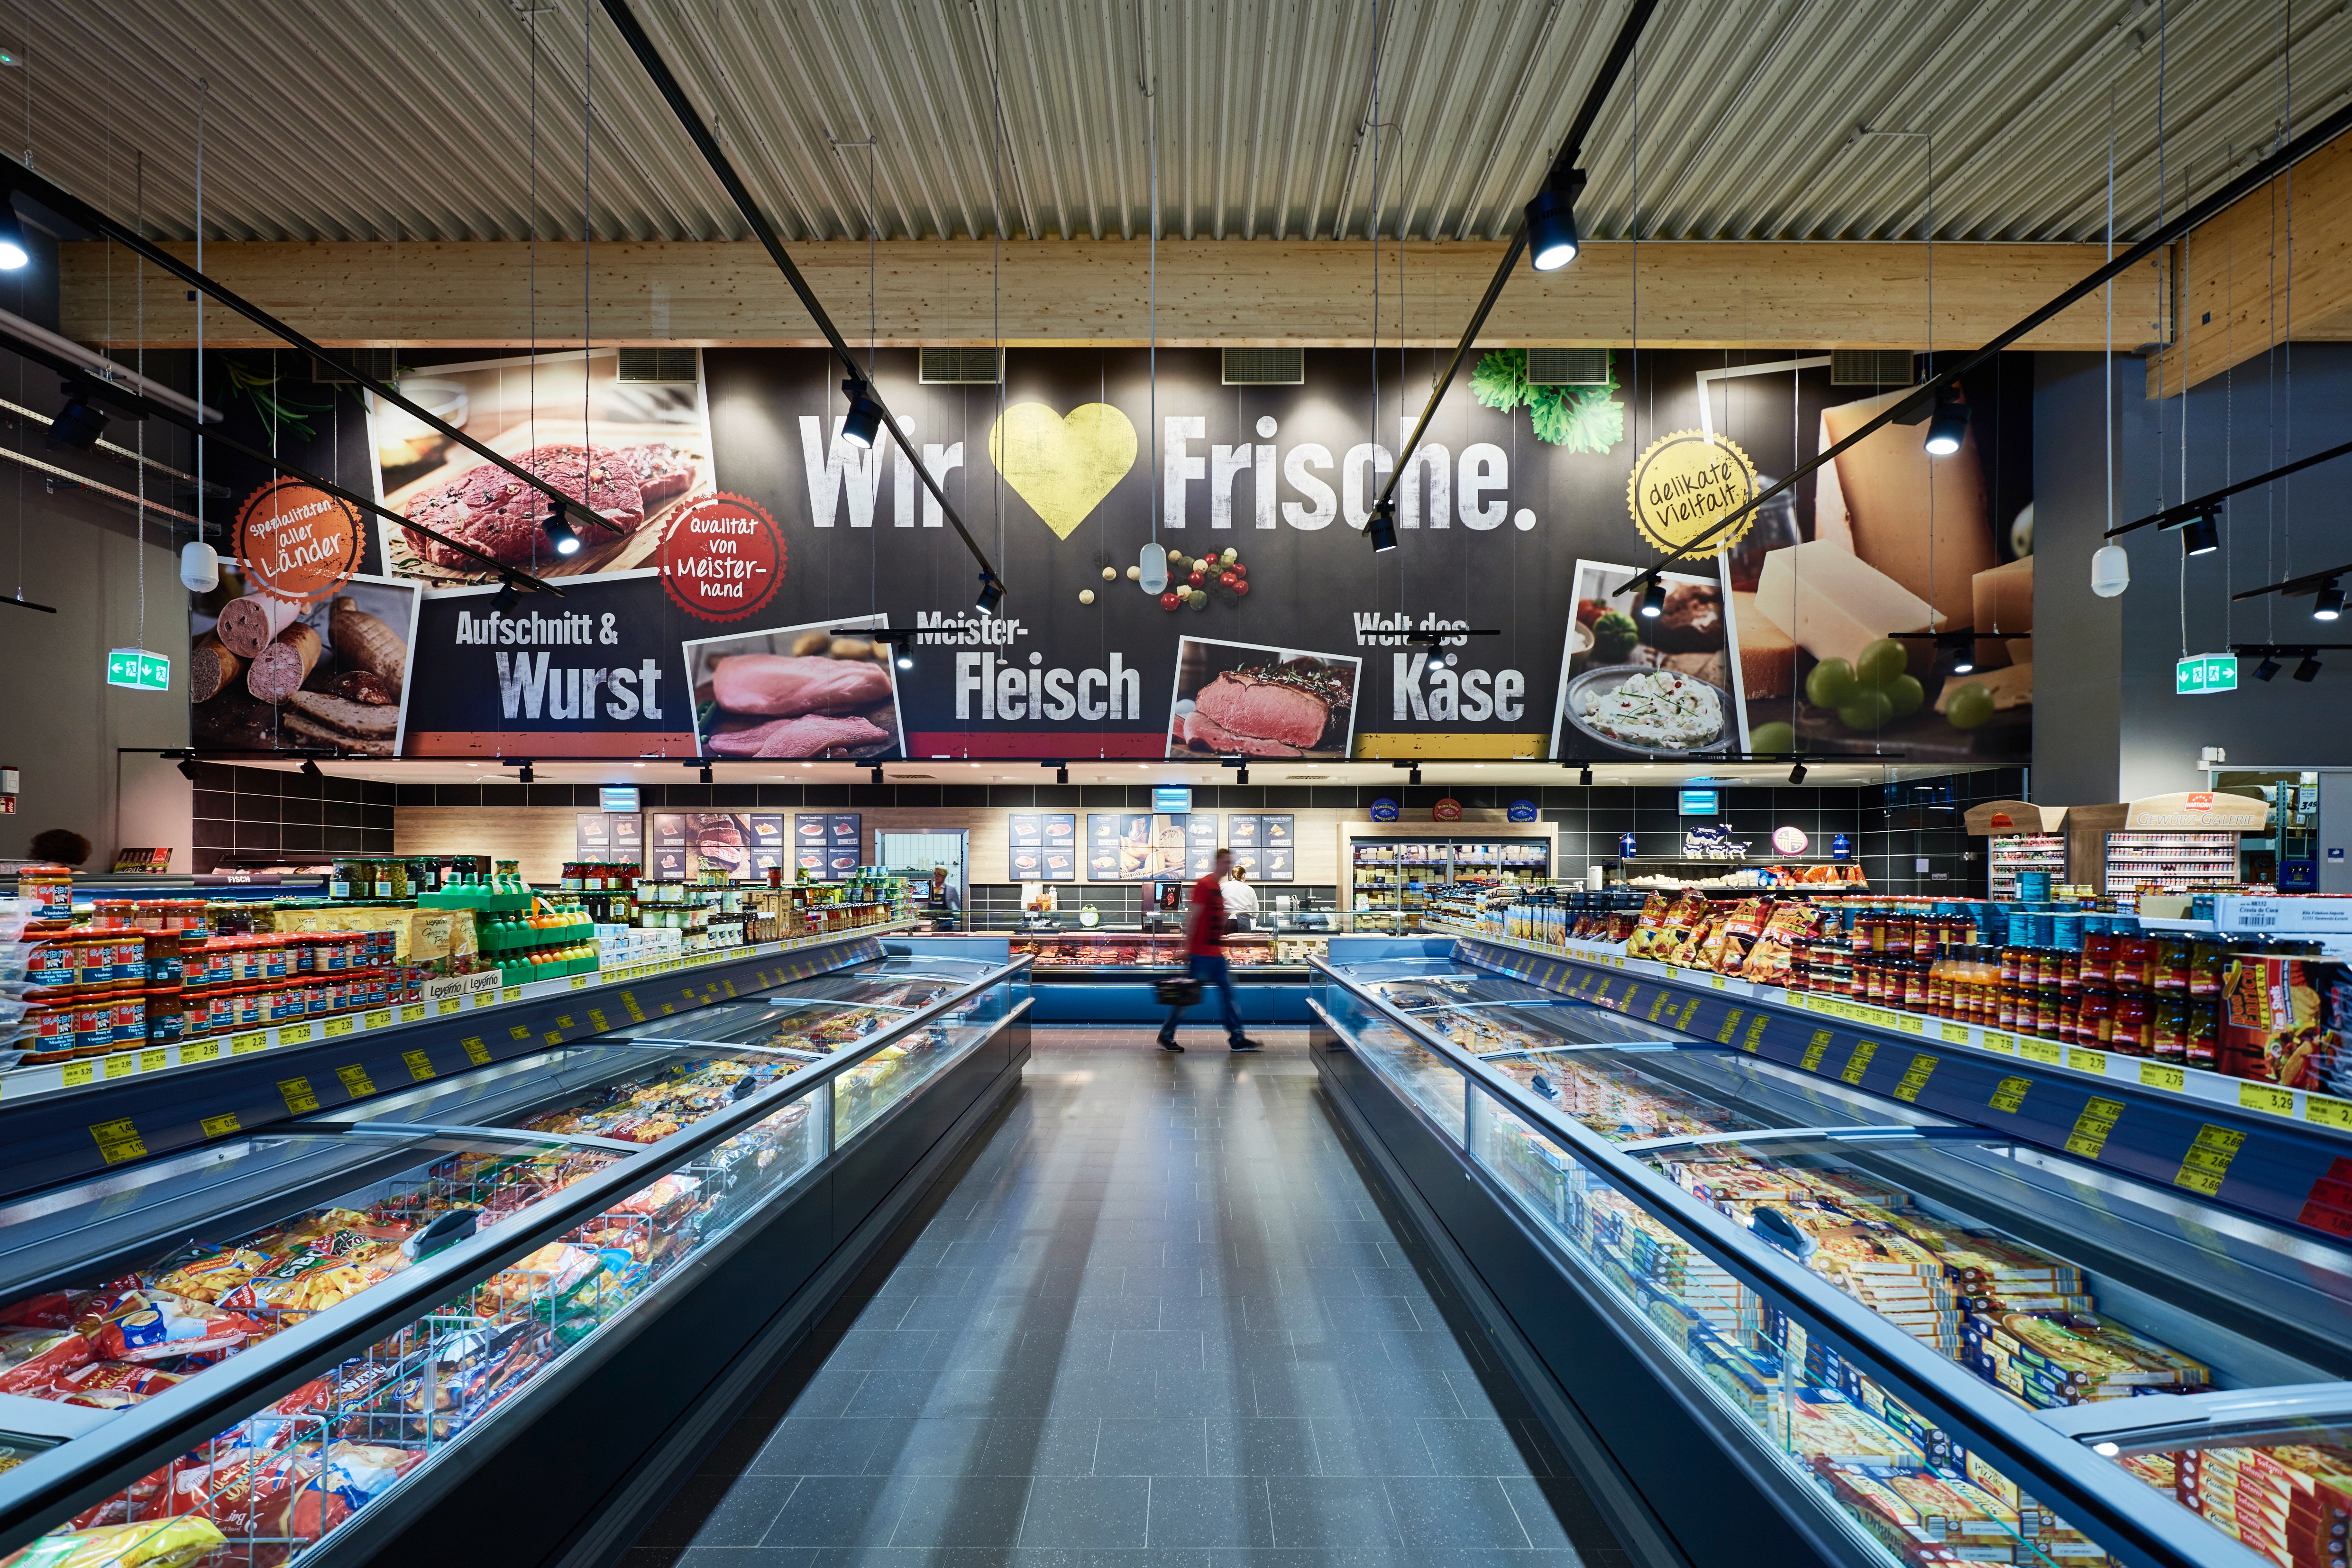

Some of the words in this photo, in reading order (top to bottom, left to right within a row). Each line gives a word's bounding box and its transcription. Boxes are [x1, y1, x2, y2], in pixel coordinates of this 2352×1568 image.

[798, 415, 963, 528] Wir
[1164, 415, 1537, 531] Frische.
[1650, 462, 1731, 505] delikate
[1656, 484, 1736, 527] Vielfalt
[249, 500, 332, 539] Spezialitäten
[690, 518, 759, 534] Qualität
[279, 523, 312, 547] aller
[709, 539, 736, 554] von
[260, 532, 340, 578] Länder
[678, 557, 766, 578] Meister-
[701, 580, 743, 597] hand
[456, 611, 593, 645] Aufschnitt
[599, 612, 618, 645] &
[917, 611, 1028, 645] Meister-
[1353, 612, 1412, 646] Welt
[495, 651, 662, 720] Wurst
[956, 651, 1140, 721] Fleisch
[1393, 653, 1525, 722] Käse
[2138, 812, 2254, 825] GEWÜRZ-GALERIE
[30, 950, 73, 959] SABITA
[470, 974, 498, 990] Leverno
[430, 981, 461, 997] Leverno
[2239, 968, 2261, 1027] Enrico
[2257, 967, 2270, 1031] MEXICANO
[1817, 1001, 1825, 1009] 2,99
[2231, 994, 2244, 1024] Don
[380, 1013, 391, 1022] 2,29
[1887, 1016, 1896, 1025] 2,39
[341, 1021, 353, 1030] 2,29
[1913, 1021, 1922, 1030] 2,39
[298, 1028, 311, 1038] 2,29
[1958, 1030, 1968, 1039] 1,99
[253, 1036, 266, 1046] 2,29
[2001, 1040, 2013, 1050] 2,39
[203, 1045, 219, 1055] 2,99
[156, 1054, 166, 1062] 2,99
[2090, 1058, 2105, 1069] 2,79
[81, 1067, 92, 1076] 3,29
[297, 1082, 309, 1090] 1,99
[2166, 1073, 2183, 1086] 2,79
[305, 1097, 318, 1106] 0,99
[2007, 1100, 2020, 1109] 2,69
[2271, 1095, 2293, 1109] 3,29
[2105, 1106, 2121, 1117] 2,69
[119, 1123, 135, 1134] 1,49
[224, 1118, 239, 1128] 0,99
[2096, 1124, 2110, 1135] 2,69
[129, 1142, 146, 1153] 1,19
[2086, 1142, 2101, 1154] 2,69
[2222, 1135, 2242, 1148] 2,69
[2210, 1156, 2231, 1169] 2,69
[2201, 1178, 2220, 1191] 2,69
[189, 1264, 218, 1274] Kartoffelsnack
[230, 1295, 238, 1306] GUT
